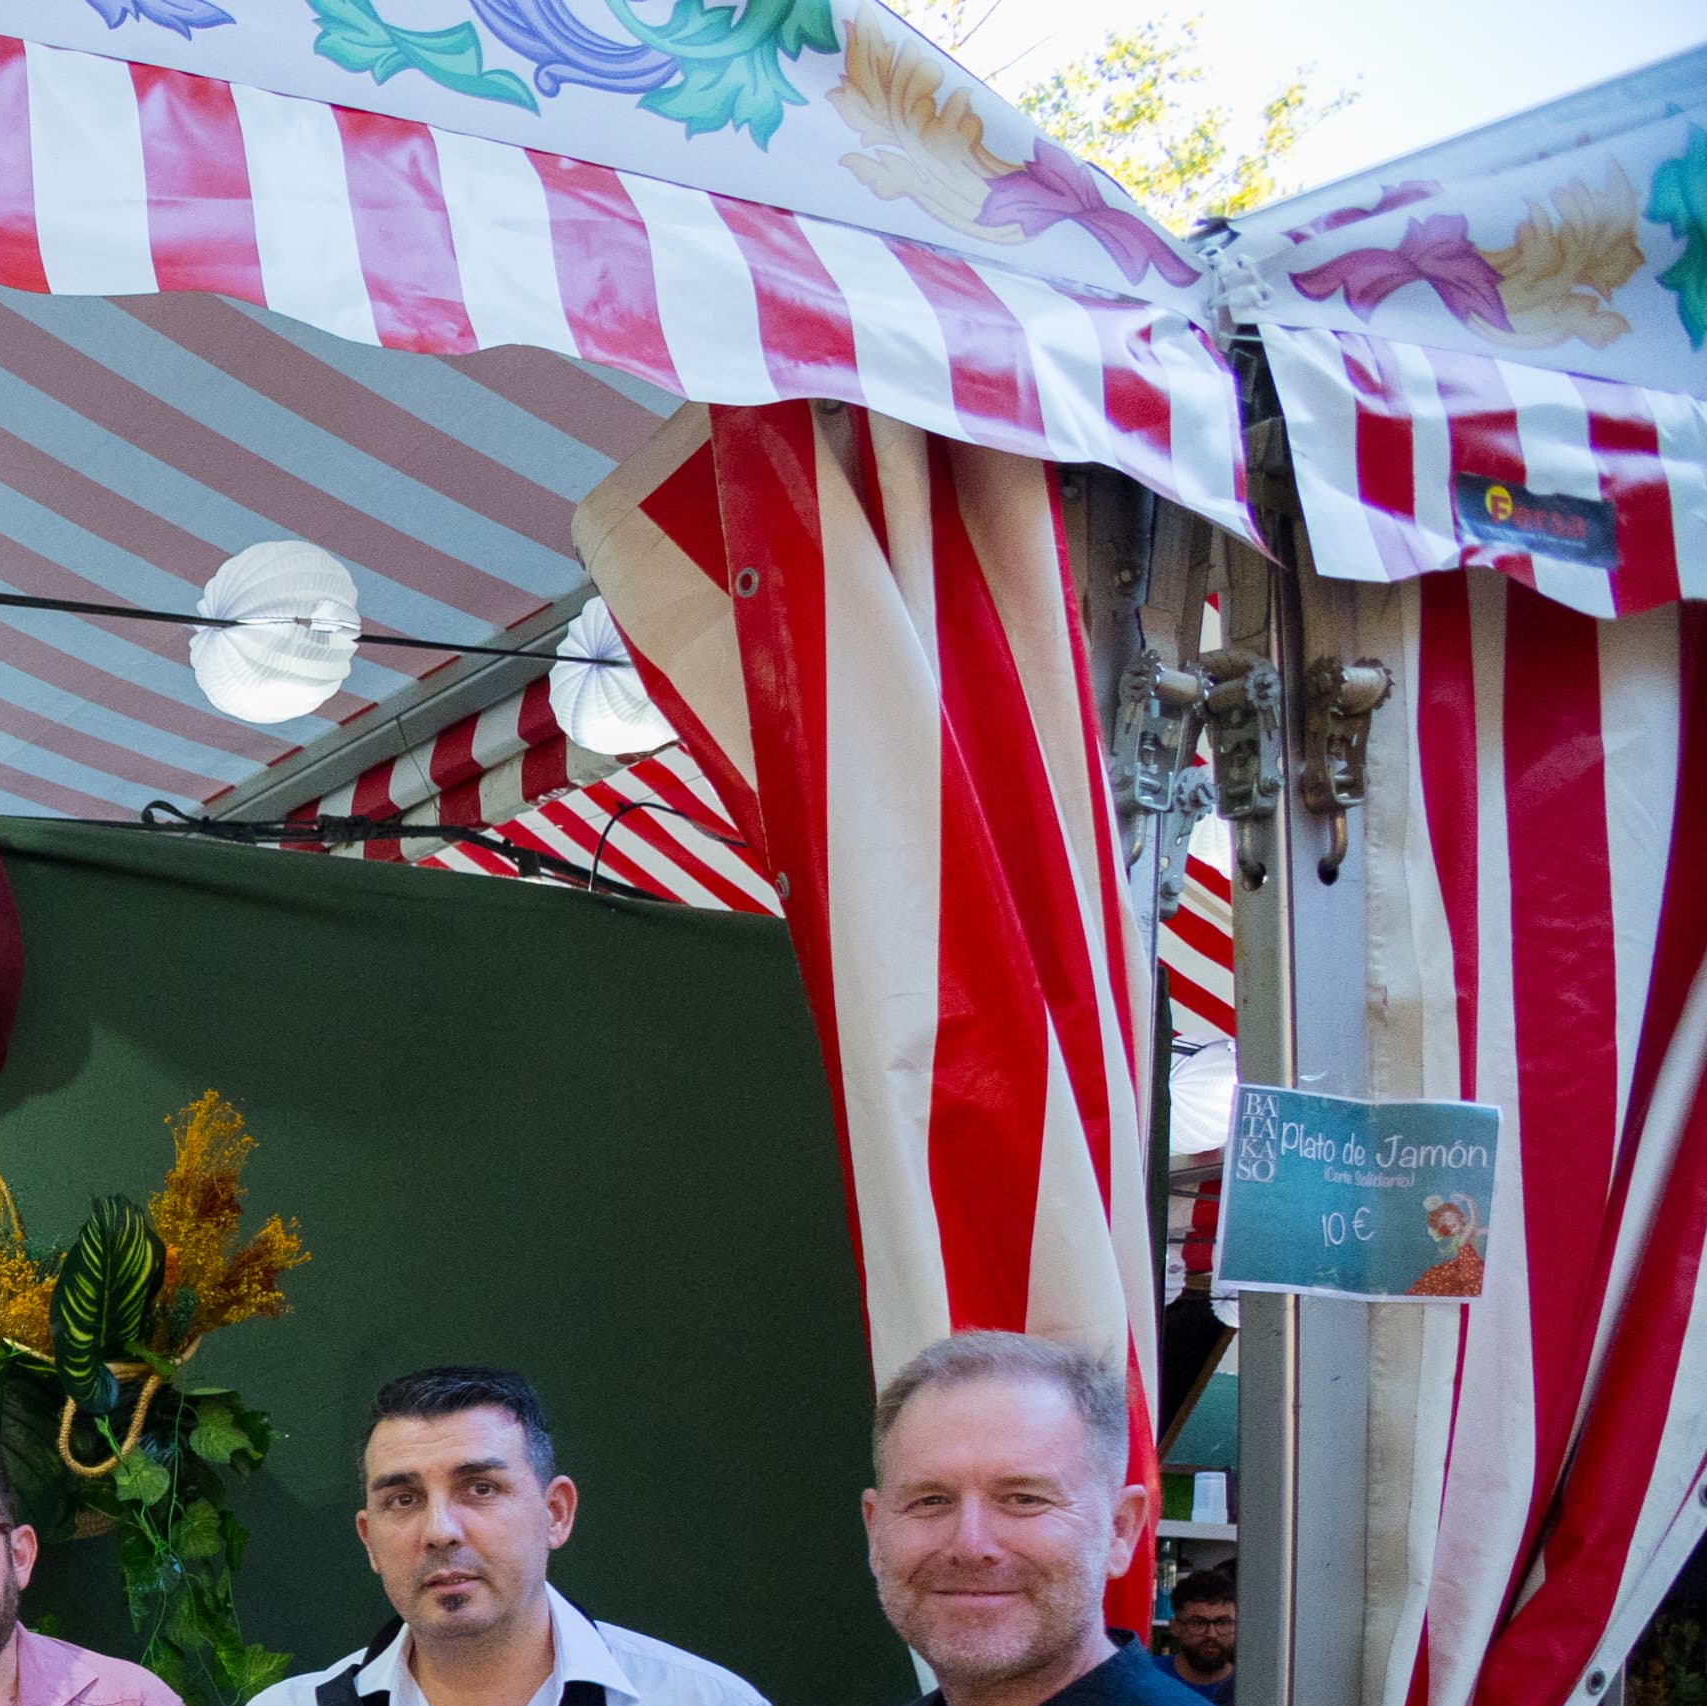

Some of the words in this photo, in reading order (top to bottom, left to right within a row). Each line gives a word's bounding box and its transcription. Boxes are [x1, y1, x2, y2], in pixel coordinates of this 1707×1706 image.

[1245, 1093, 1278, 1117] BA
[1242, 1116, 1276, 1139] TA
[1240, 1139, 1276, 1159] KA
[1280, 1122, 1336, 1163] Plato
[1342, 1133, 1365, 1166] de
[1375, 1134, 1488, 1169] Jamón
[1237, 1159, 1275, 1182] SO
[1321, 1212, 1346, 1248] 10
[1351, 1206, 1377, 1241] €
